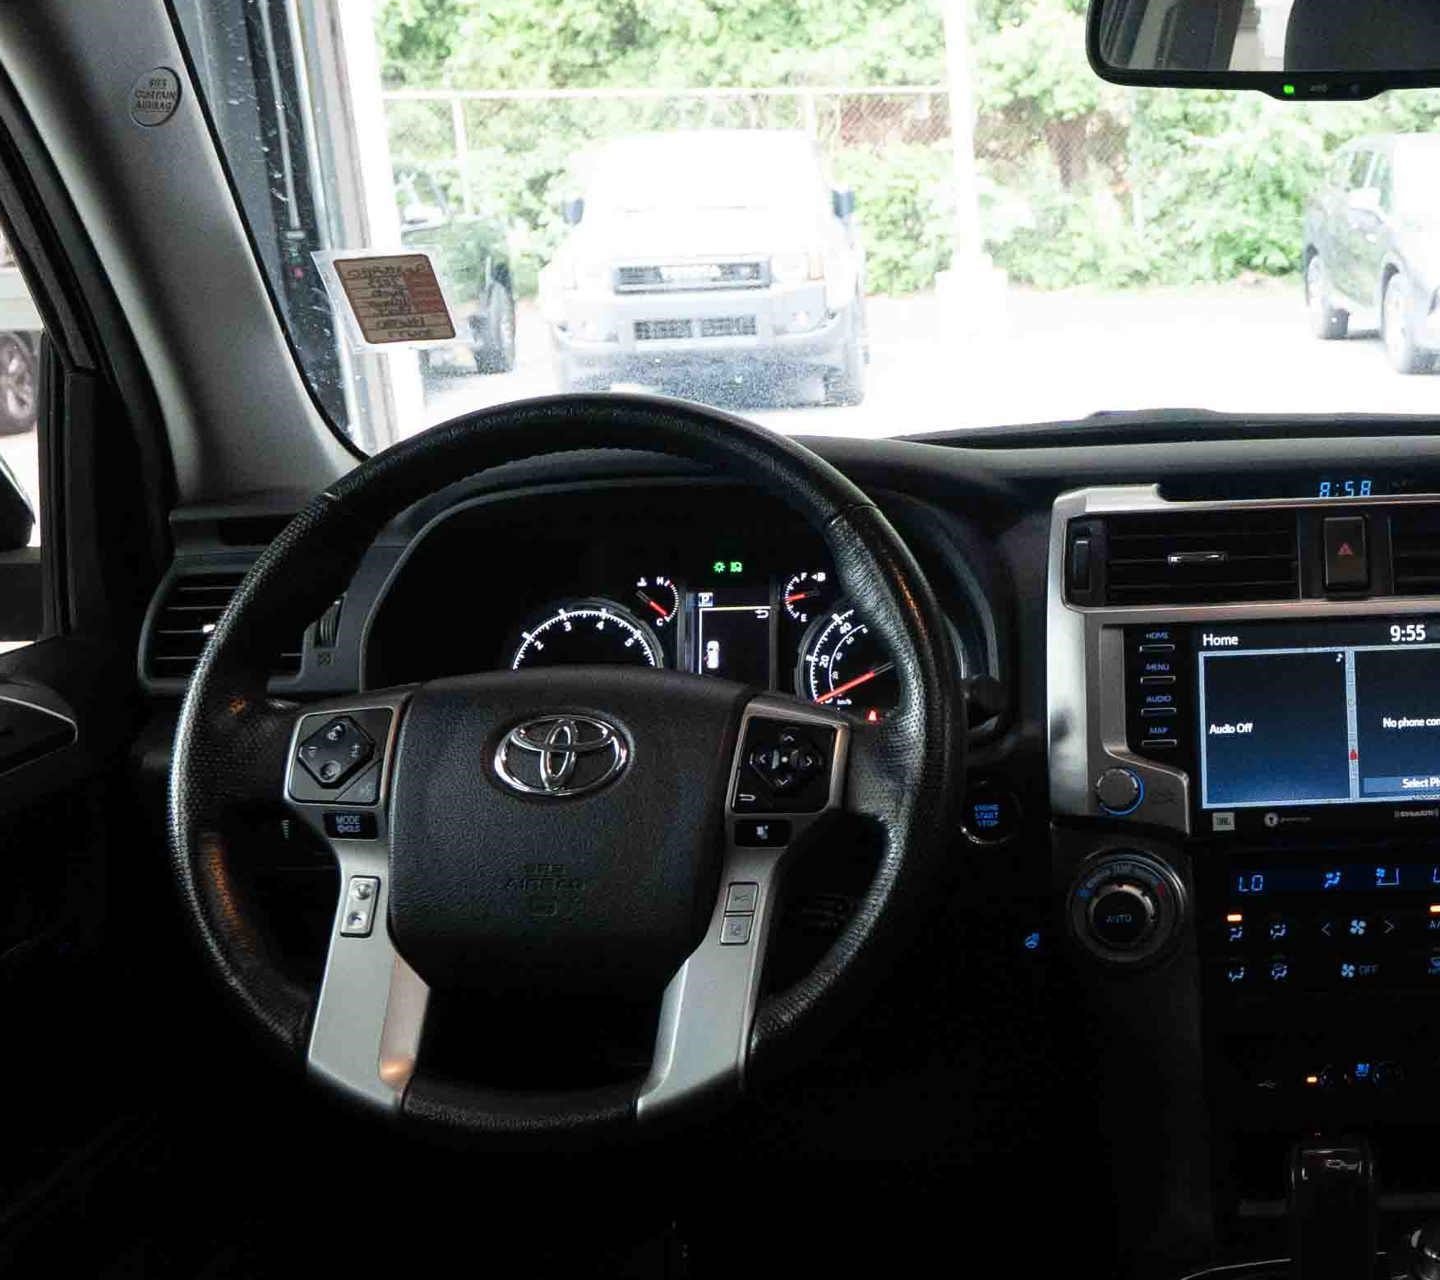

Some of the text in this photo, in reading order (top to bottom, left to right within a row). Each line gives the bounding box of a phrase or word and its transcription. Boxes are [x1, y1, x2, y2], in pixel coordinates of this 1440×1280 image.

[1320, 480, 1372, 498] 8:58
[1202, 633, 1240, 647] Home
[1389, 624, 1427, 643] 9:55
[1145, 663, 1170, 671] MENU
[1145, 695, 1172, 704] AUDIO
[1209, 722, 1254, 735] Audio Off
[1382, 716, 1397, 728] No
[1398, 716, 1425, 729] phone
[1401, 778, 1429, 788] Select
[335, 815, 361, 825] MODE
[1237, 874, 1264, 893] LO
